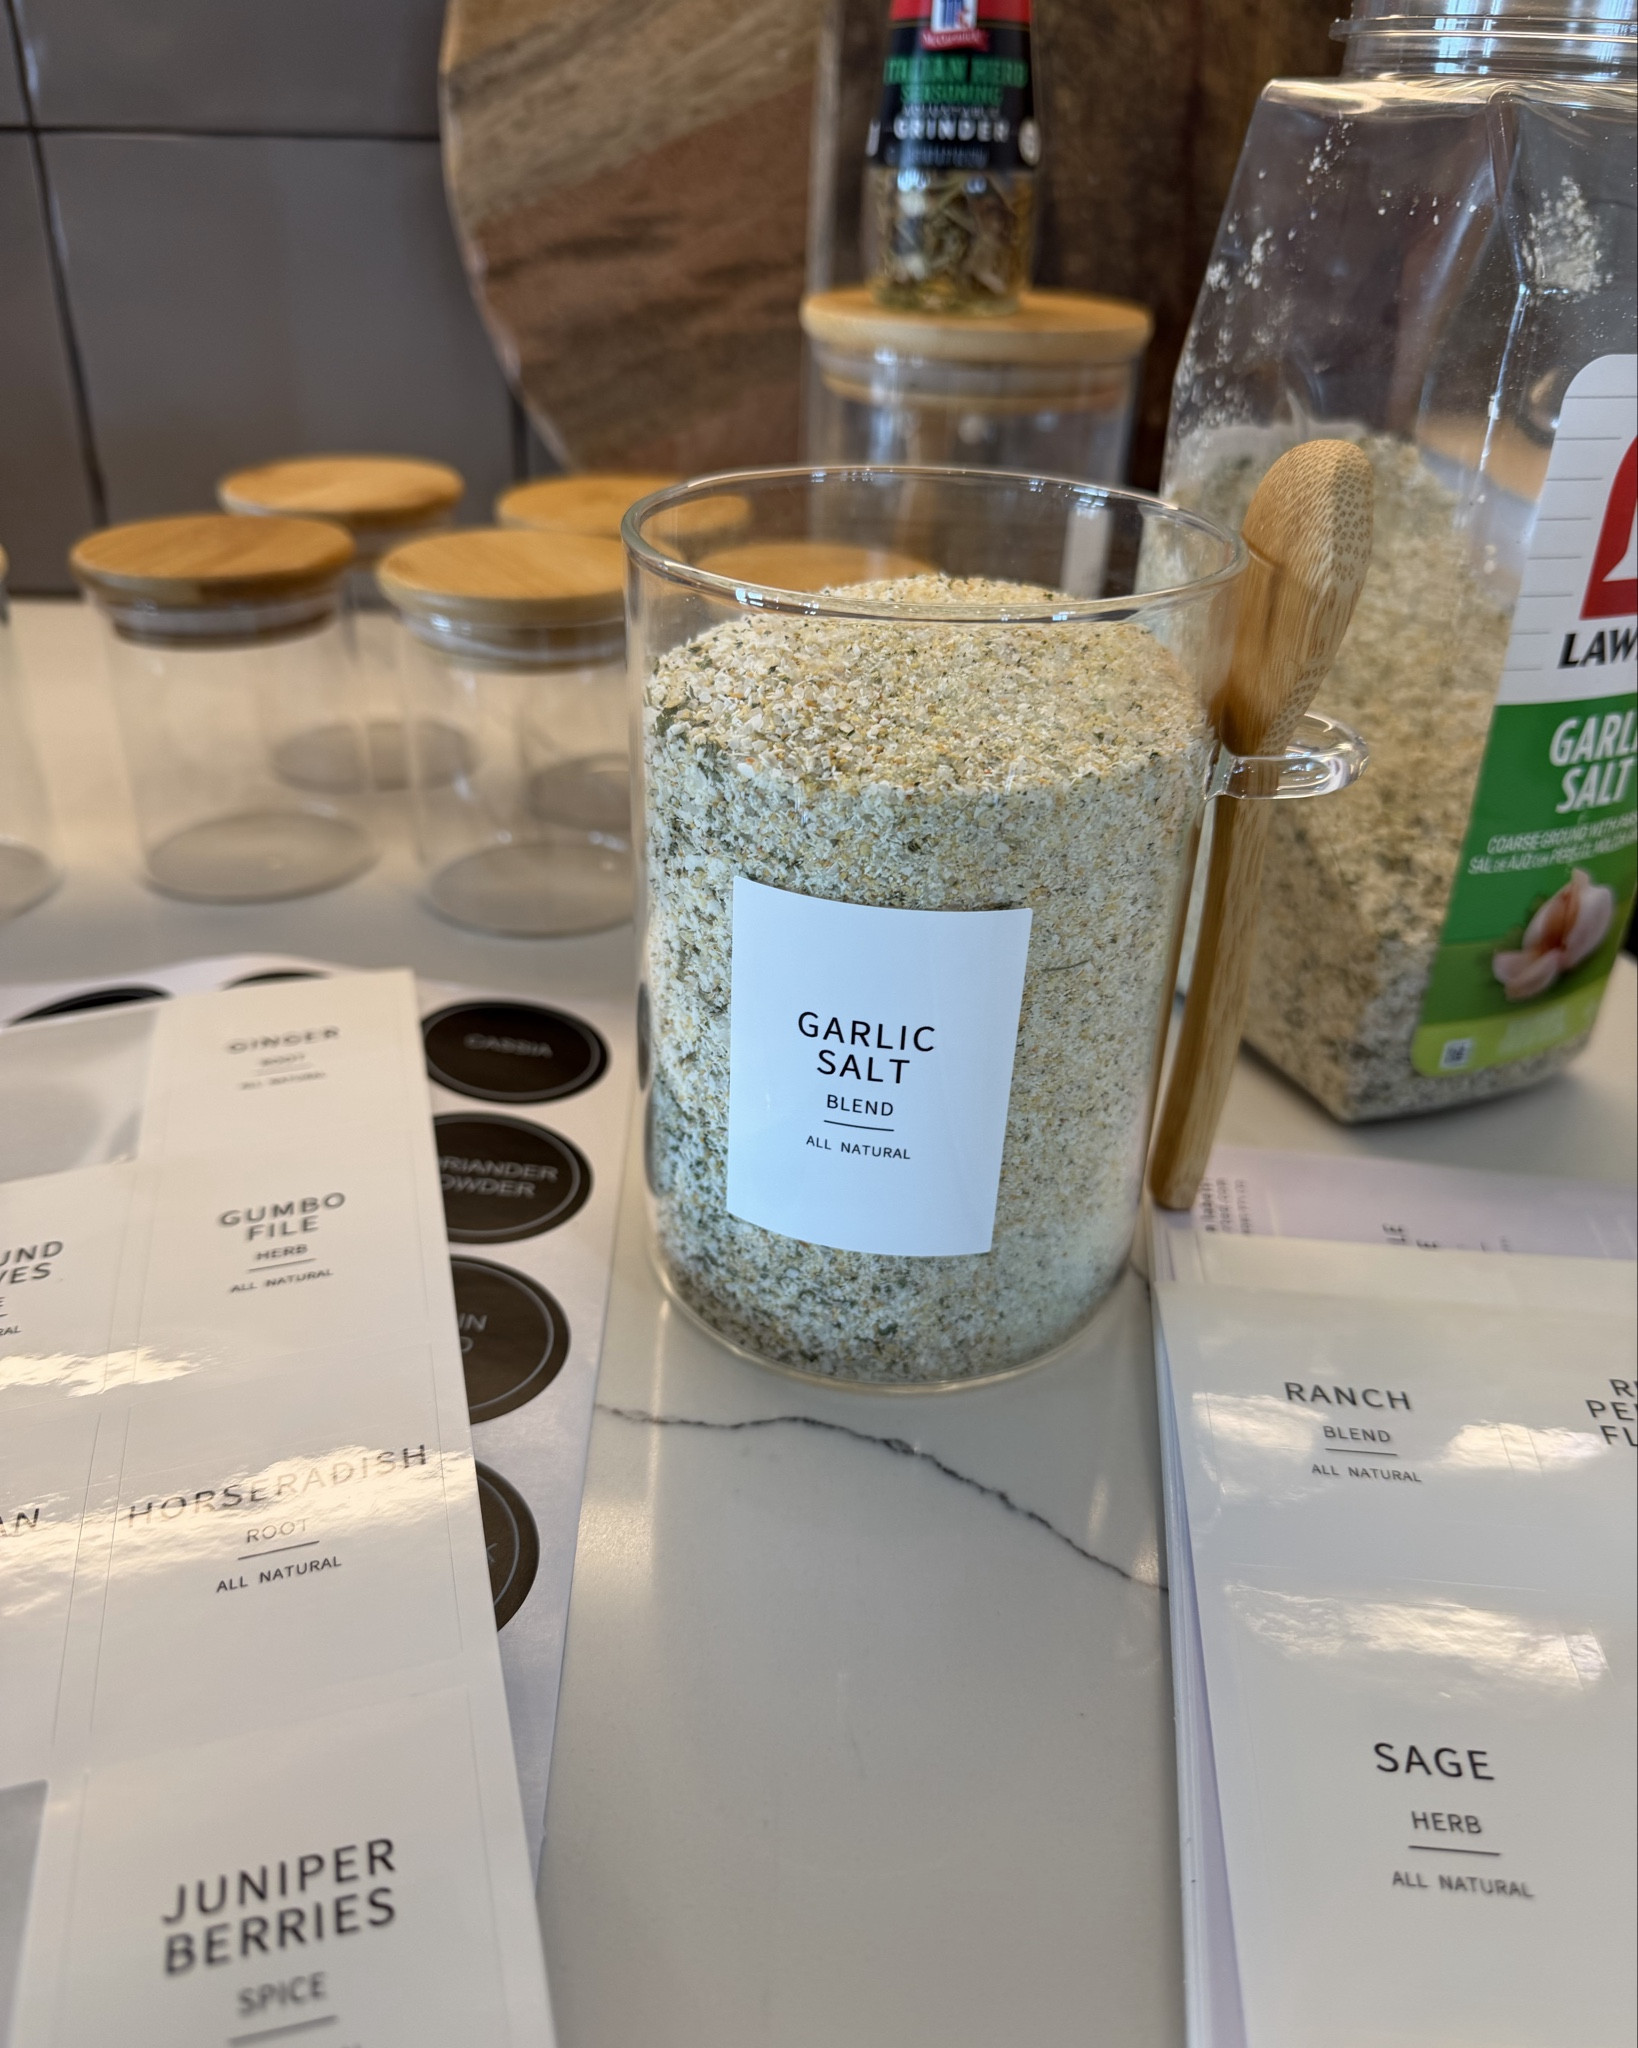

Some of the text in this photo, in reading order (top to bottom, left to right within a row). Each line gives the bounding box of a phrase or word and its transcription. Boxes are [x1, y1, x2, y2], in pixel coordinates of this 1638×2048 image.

[893, 116, 1010, 142] GRINDER
[1555, 757, 1635, 813] SALT
[464, 1032, 554, 1058] CASSIA
[798, 1011, 936, 1053] GARLIC
[816, 1049, 910, 1084] SALT
[826, 1093, 894, 1117] BLEND
[805, 1134, 911, 1160] ALL NATURAL
[439, 1156, 558, 1182] RIANDER
[440, 1174, 536, 1198] OWDER
[219, 1192, 346, 1227] GUMBO
[245, 1214, 318, 1242] FILE
[255, 1244, 308, 1261] HERB
[230, 1268, 333, 1294] ALL NATURAL
[1284, 1381, 1412, 1411] RANCH
[1322, 1425, 1392, 1444] BLEND
[127, 1444, 427, 1528] HORSERADISH
[1311, 1463, 1422, 1483] ALL NATURAL
[246, 1518, 310, 1544] ROOT
[216, 1555, 342, 1593] ALL NATURAL
[1373, 1742, 1495, 1781] SAGE
[1411, 1810, 1483, 1835] HERB
[161, 1838, 396, 1925] JUNIPER
[1392, 1870, 1534, 1898] ALL NATURAL
[164, 1888, 396, 1977] BERRIES
[236, 1971, 327, 2018] SPICE
